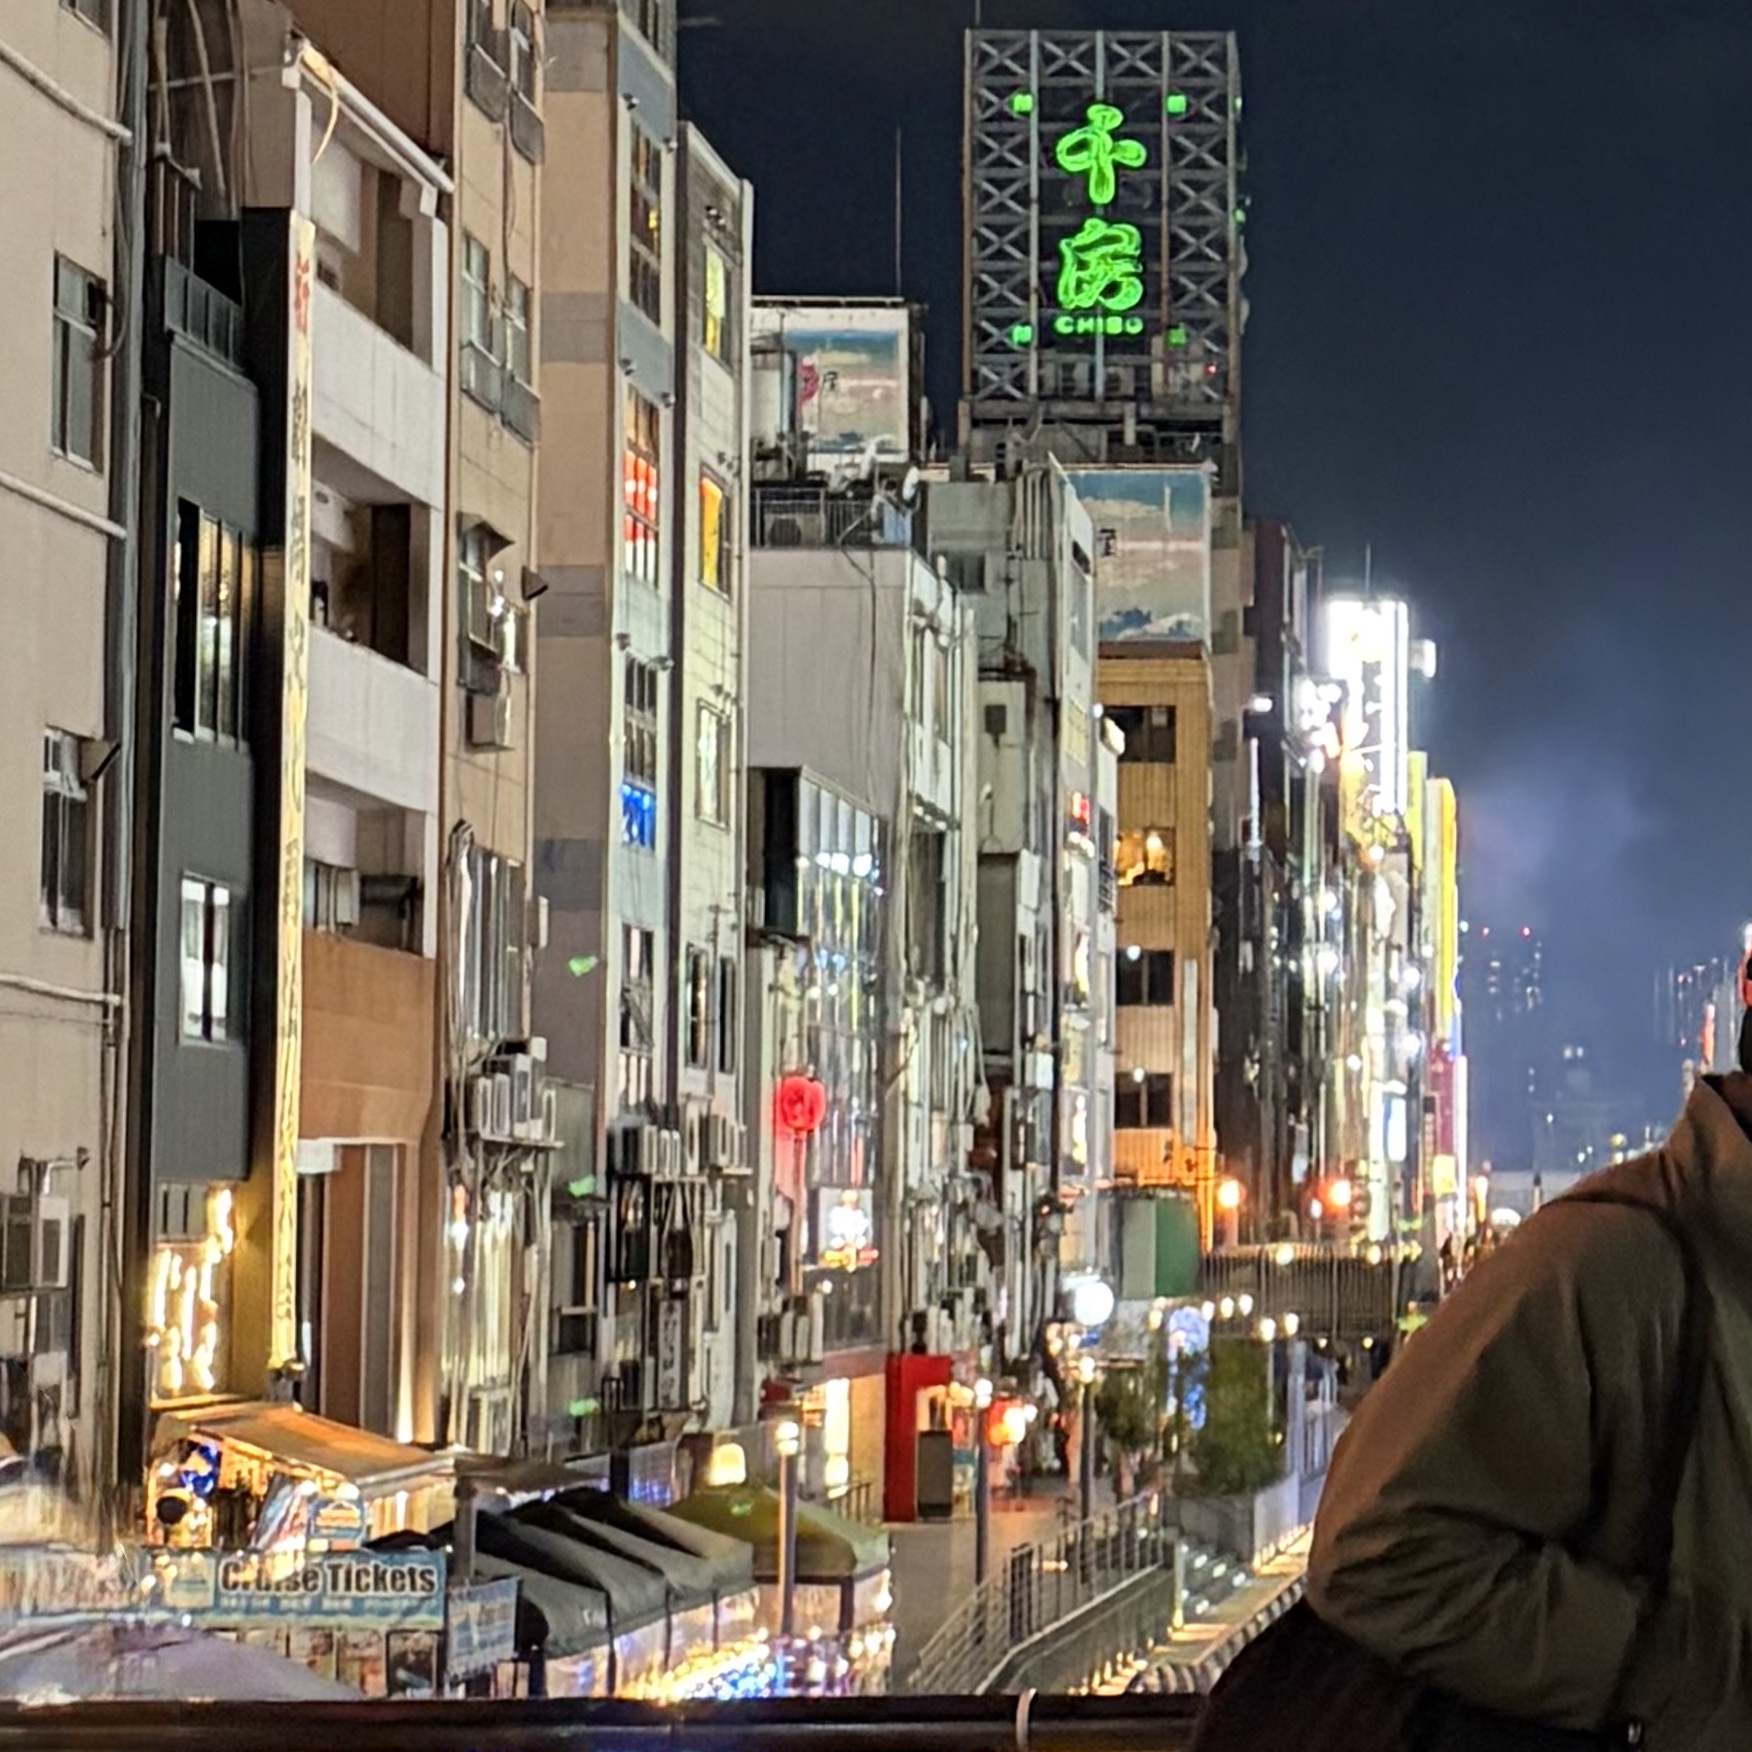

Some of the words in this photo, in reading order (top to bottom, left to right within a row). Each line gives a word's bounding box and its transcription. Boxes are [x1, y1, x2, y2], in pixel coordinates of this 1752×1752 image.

[1054, 315, 1144, 335] CHIBO
[221, 1560, 321, 1593] Cuse
[326, 1561, 437, 1594] Tickets
